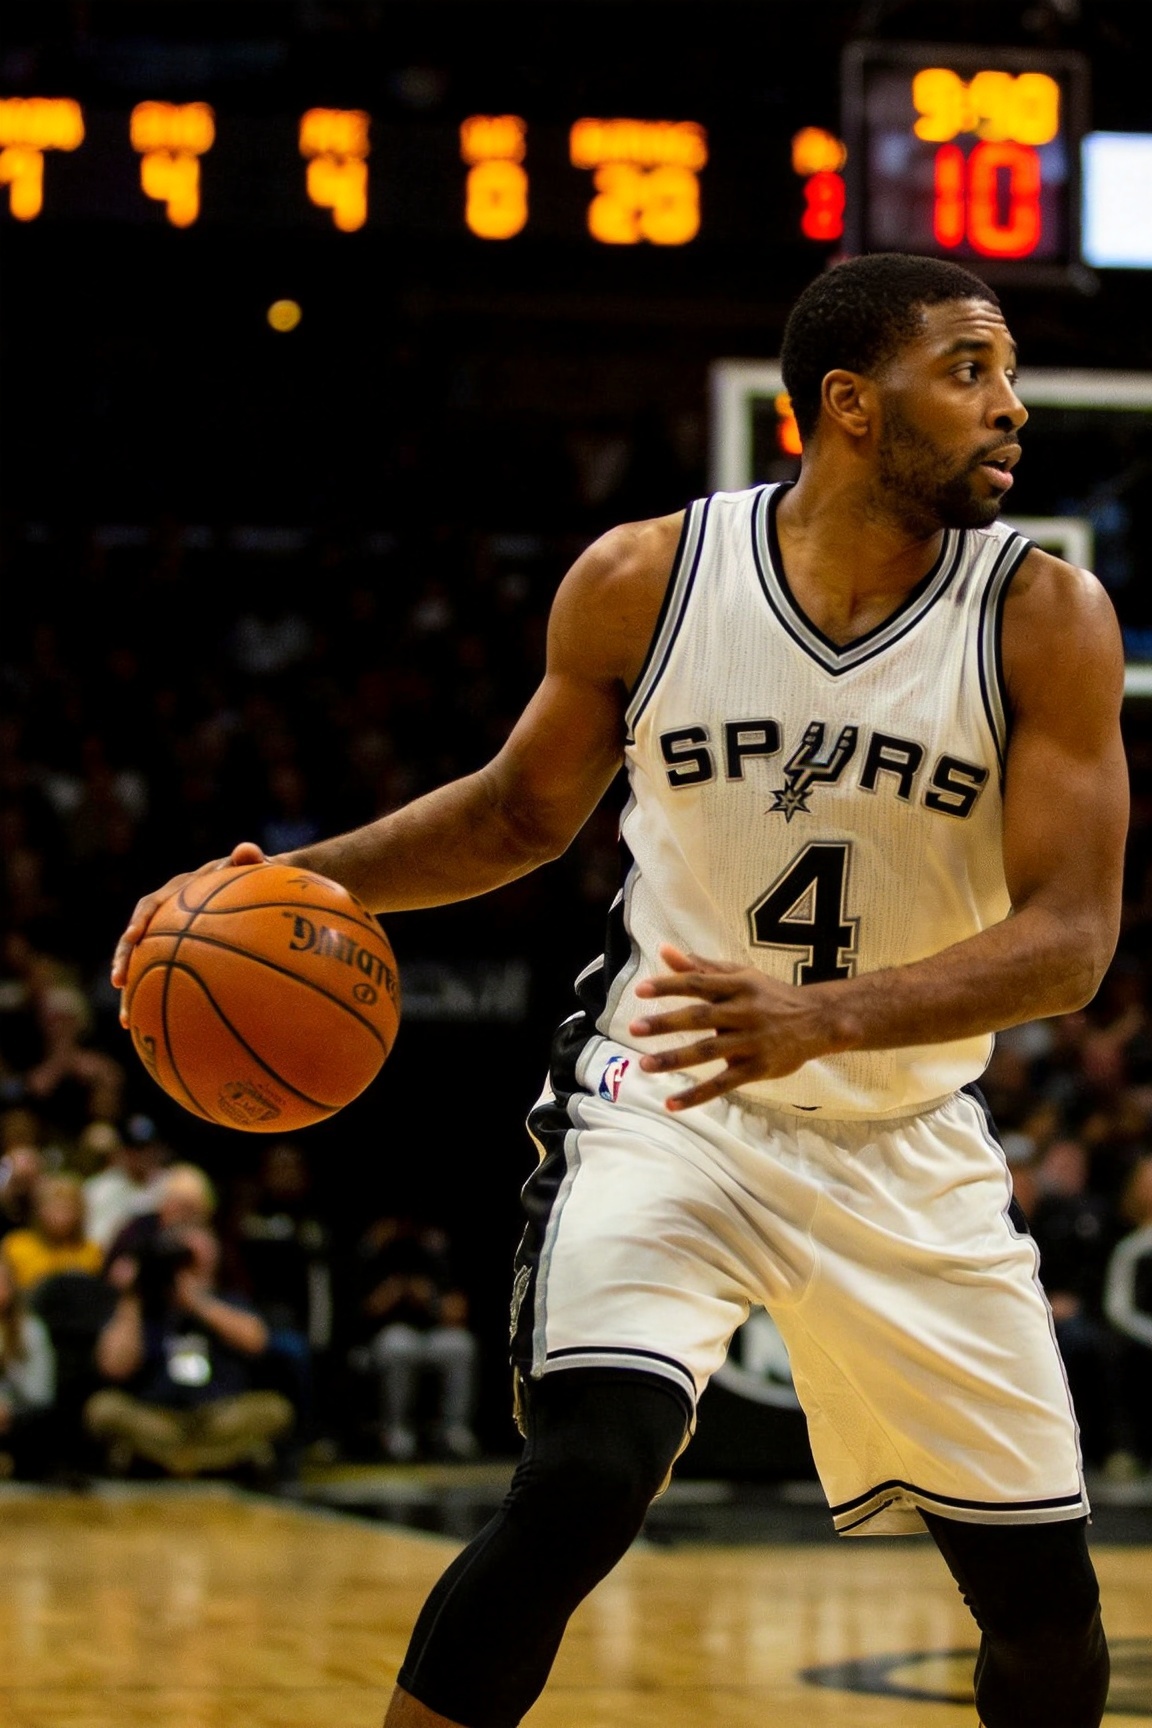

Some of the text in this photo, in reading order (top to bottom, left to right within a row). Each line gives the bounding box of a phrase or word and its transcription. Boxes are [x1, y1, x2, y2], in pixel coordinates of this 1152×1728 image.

[934, 141, 1041, 259] 10
[659, 717, 990, 822] SPURS
[748, 840, 861, 985] 4
